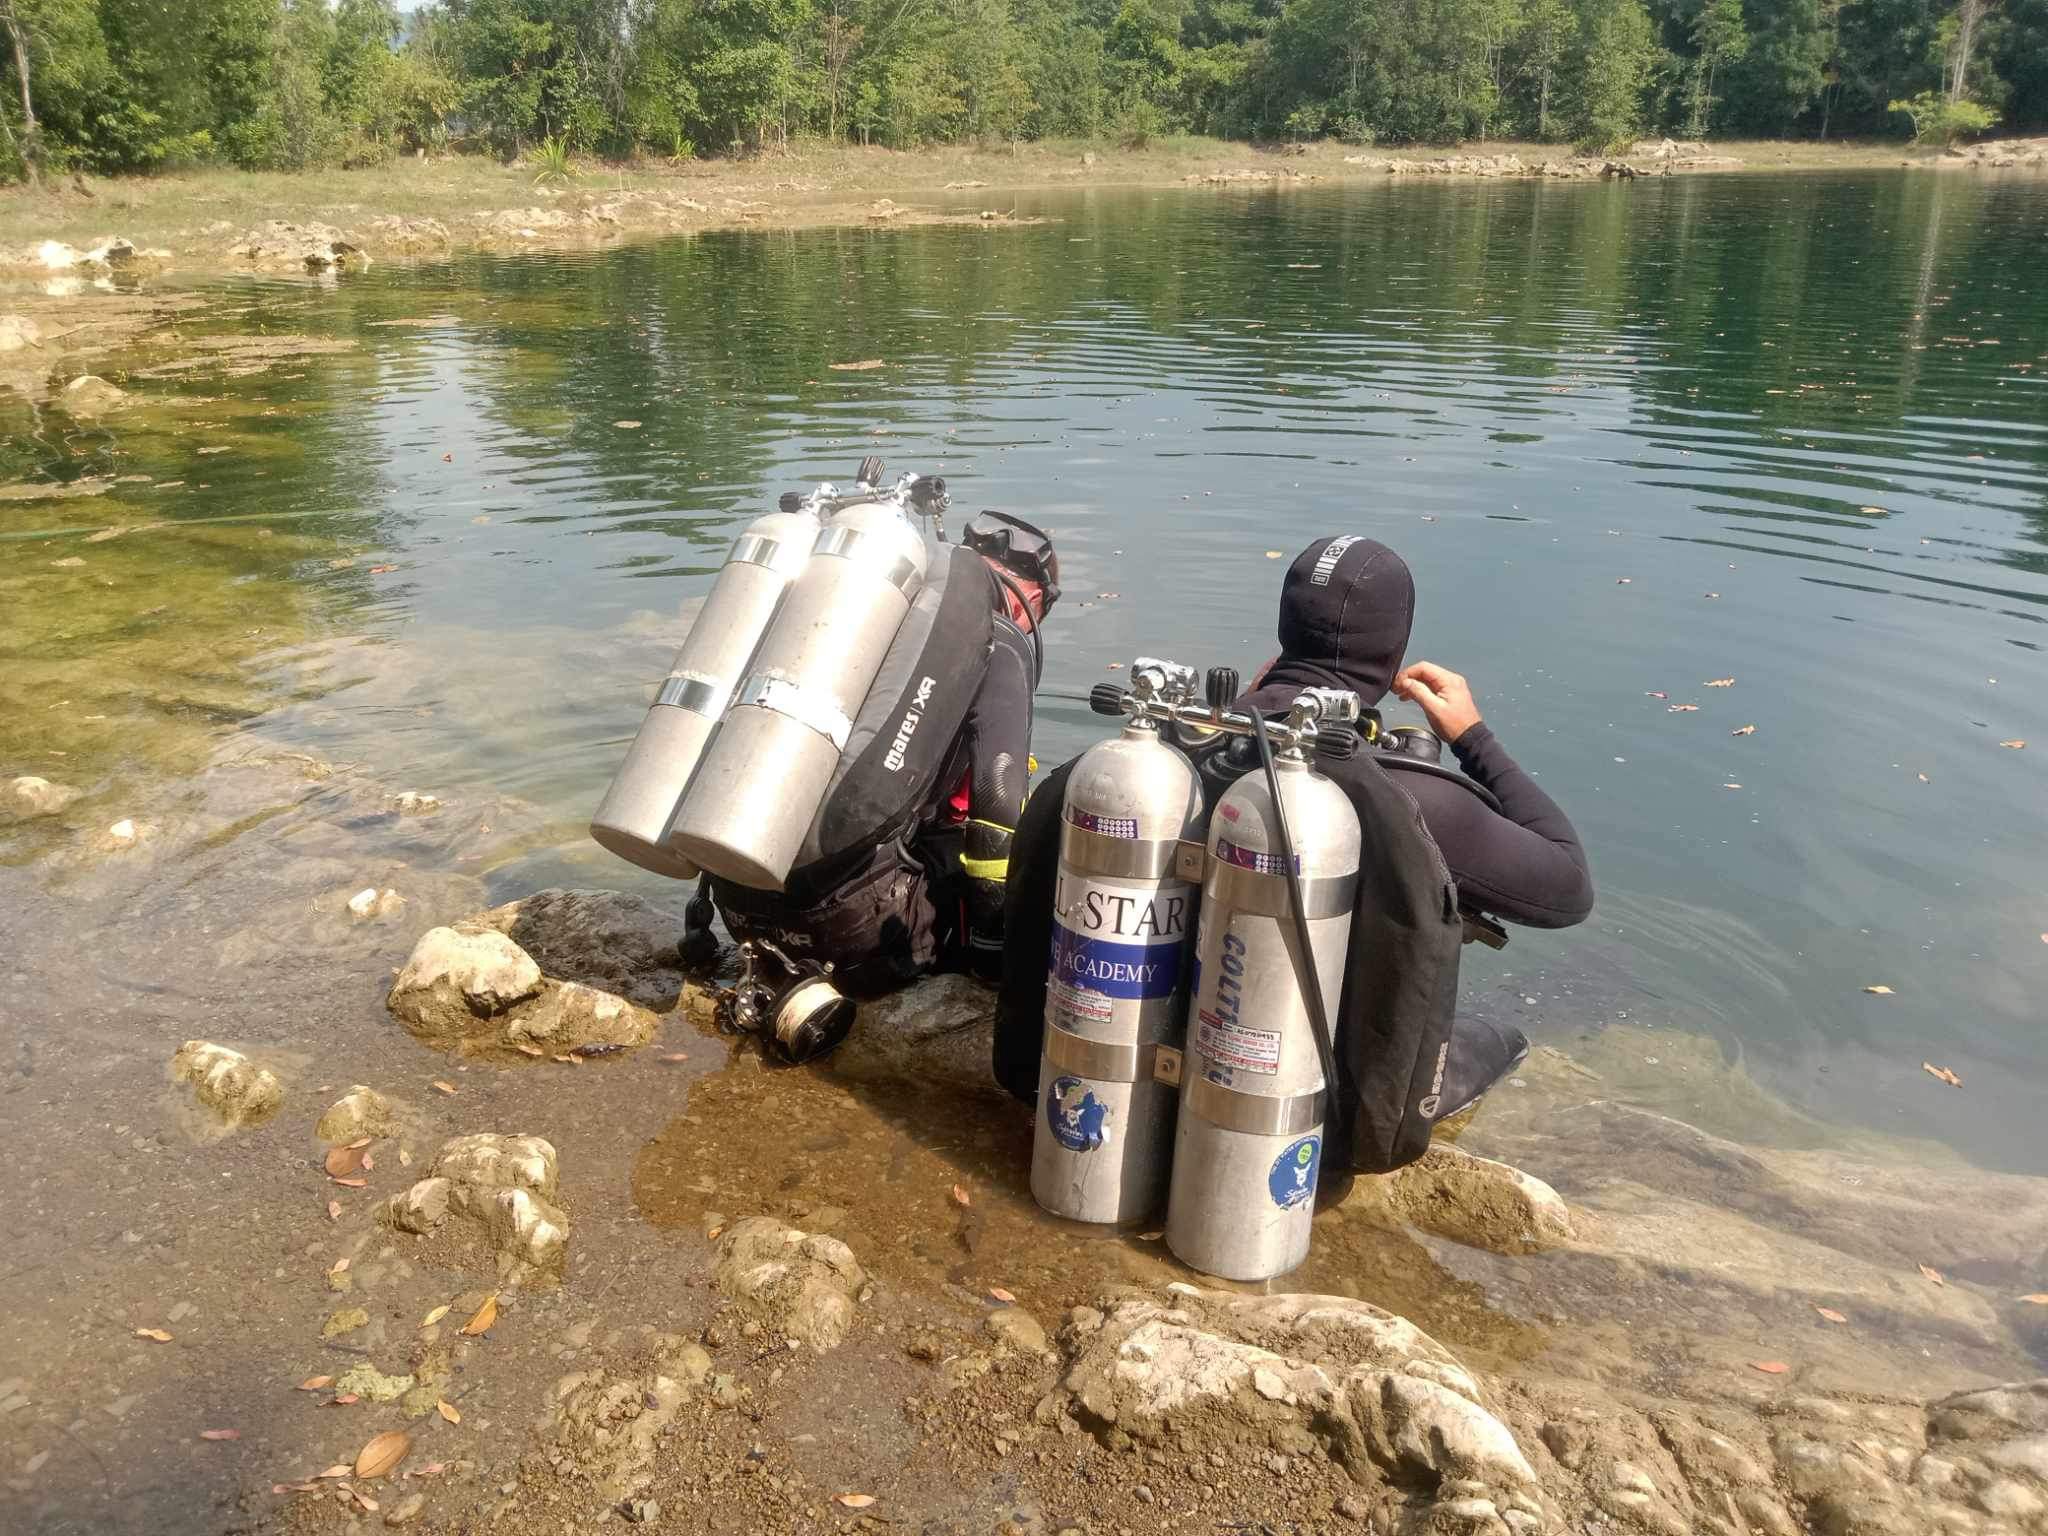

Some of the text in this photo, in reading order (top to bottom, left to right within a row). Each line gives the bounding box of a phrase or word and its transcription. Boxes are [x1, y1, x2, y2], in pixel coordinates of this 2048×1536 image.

[883, 675, 937, 771] mares XR
[1083, 890, 1185, 937] STAR
[1063, 950, 1158, 983] ACADEMY
